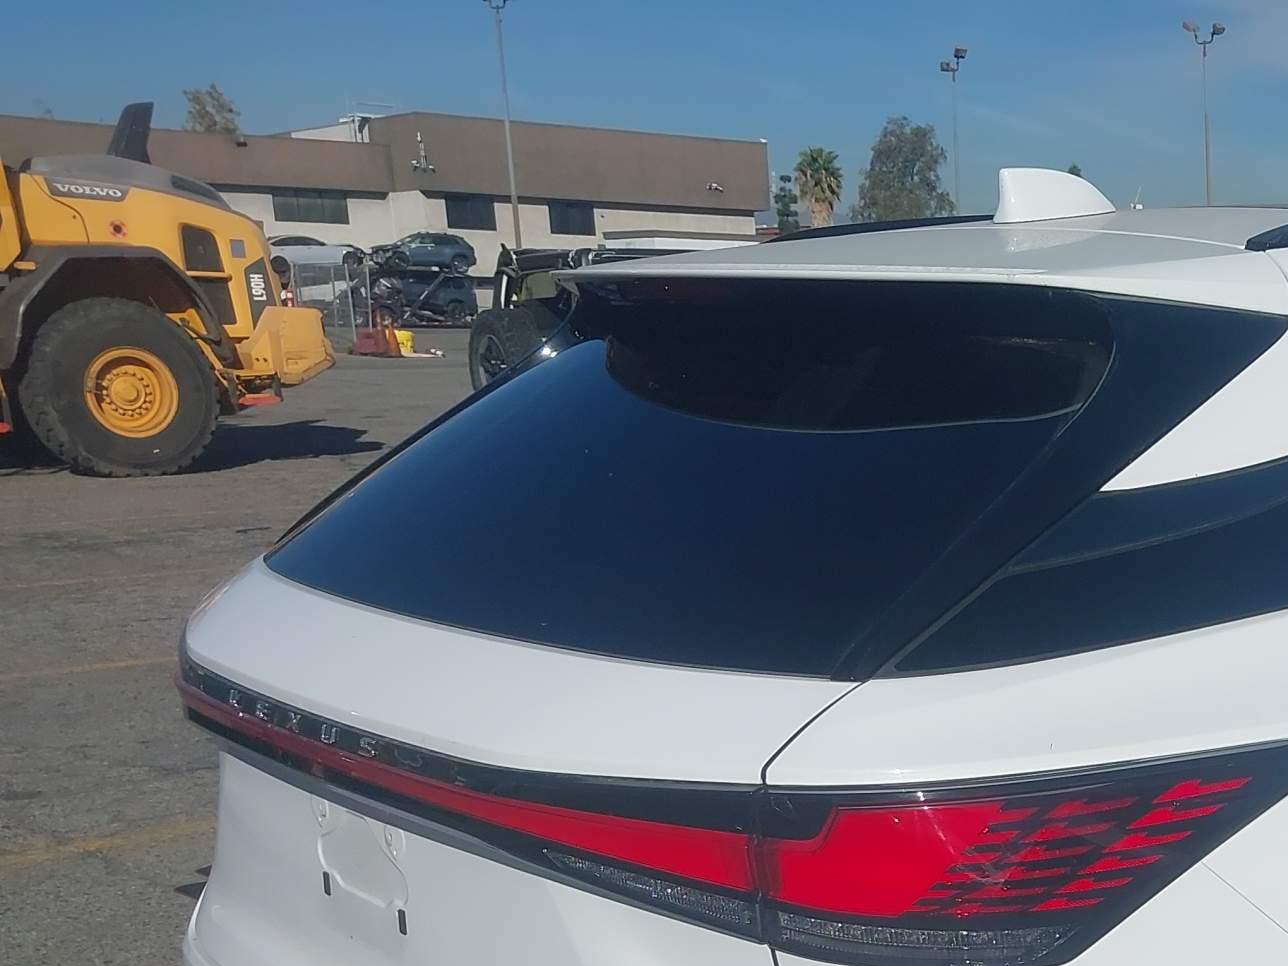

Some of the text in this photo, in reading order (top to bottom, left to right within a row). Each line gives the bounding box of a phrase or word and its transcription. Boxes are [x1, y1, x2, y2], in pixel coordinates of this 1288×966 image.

[53, 183, 123, 198] VOLVO
[249, 273, 267, 301] L90H
[228, 689, 378, 758] LEXUS
